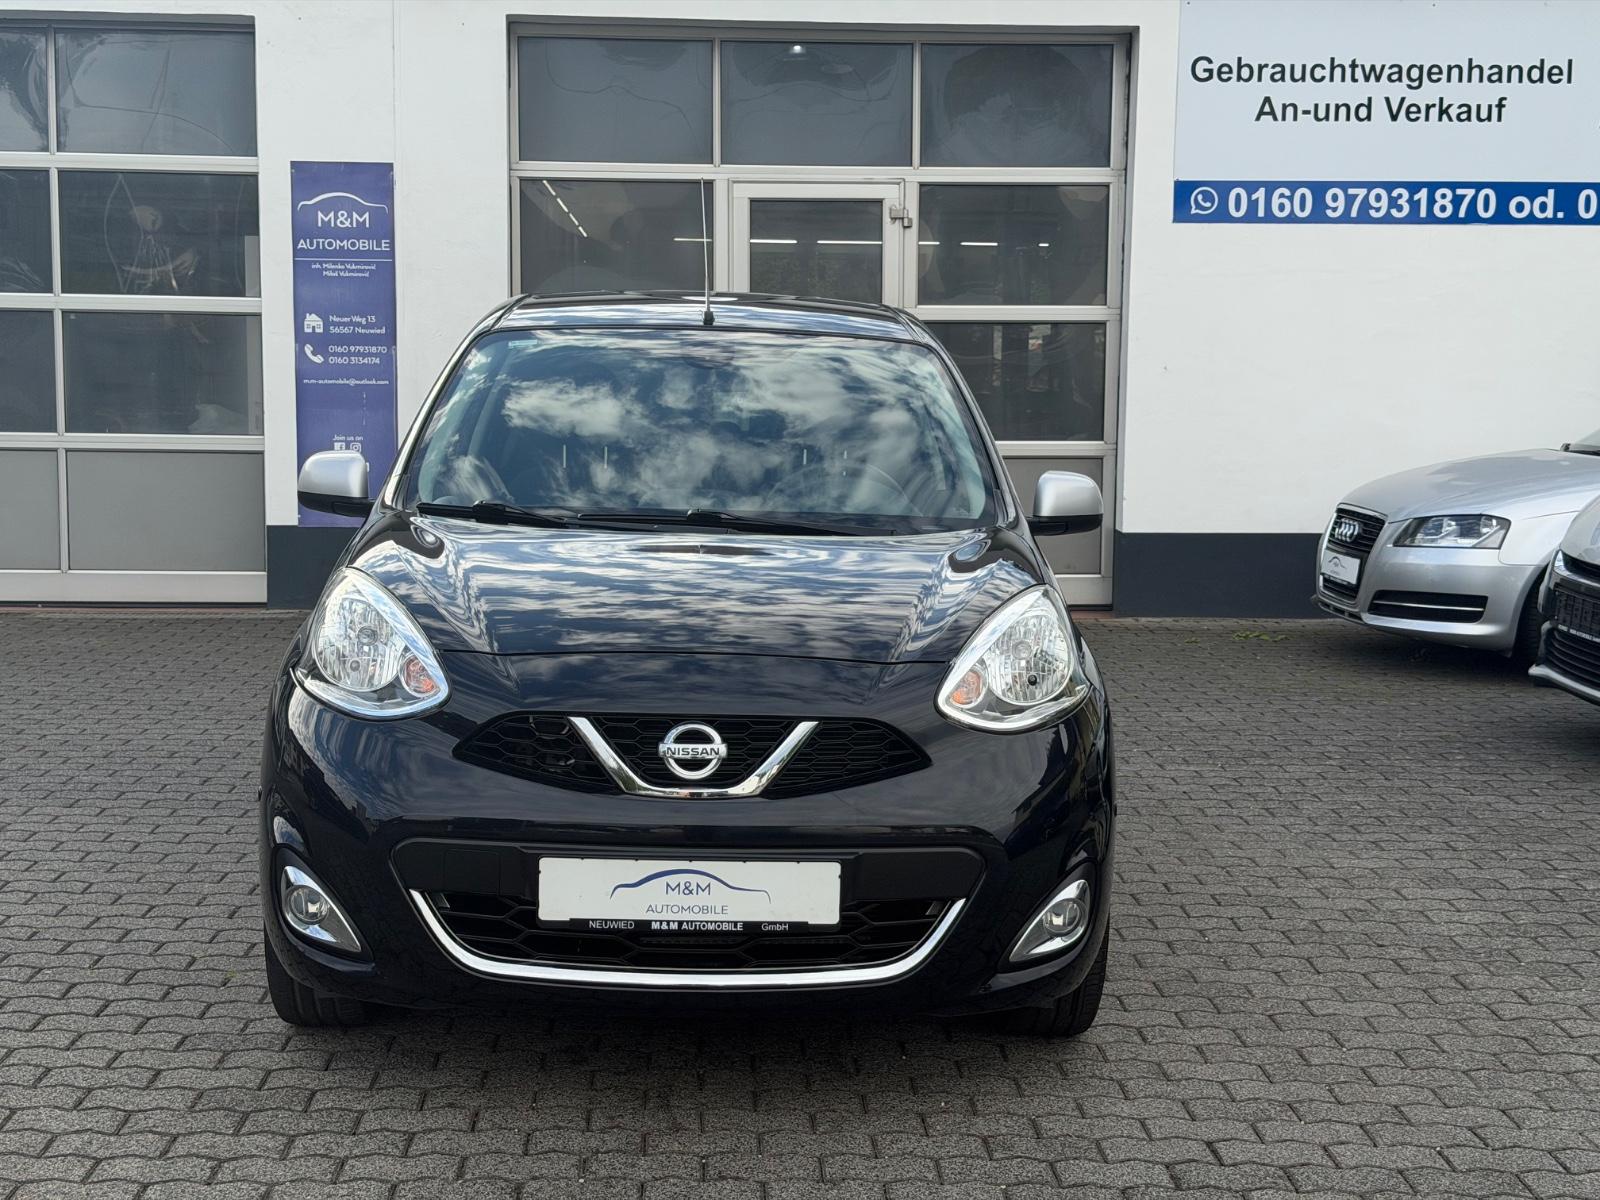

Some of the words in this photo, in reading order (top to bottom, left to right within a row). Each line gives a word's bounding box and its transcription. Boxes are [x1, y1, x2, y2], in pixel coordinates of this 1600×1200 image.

[1190, 55, 1574, 90] Gebrauchtwagenhandel
[1254, 96, 1373, 123] An-und
[1384, 96, 1507, 124] Verkauf
[1227, 186, 1313, 218] 0160
[1325, 187, 1497, 219] 97931870
[1508, 189, 1565, 219] od.
[317, 210, 370, 228] M&M
[297, 238, 391, 251] AUTOMOBILE
[329, 315, 351, 323] Neuer
[351, 315, 367, 325] Weg
[367, 315, 376, 323] 13
[329, 326, 353, 334] 56567
[354, 326, 386, 334] Neuwied
[328, 345, 349, 353] 0160
[349, 345, 388, 354] 97931870
[328, 356, 349, 364] 0160
[349, 356, 381, 365] 3134174
[666, 747, 720, 756] NISSAN
[665, 881, 711, 896] M&M
[645, 904, 729, 915] AUTOMOBILE
[588, 920, 635, 929] NEUWIED
[651, 922, 679, 930] M&M
[681, 922, 744, 931] AUTOMOBILE
[761, 923, 789, 931] GmbH
